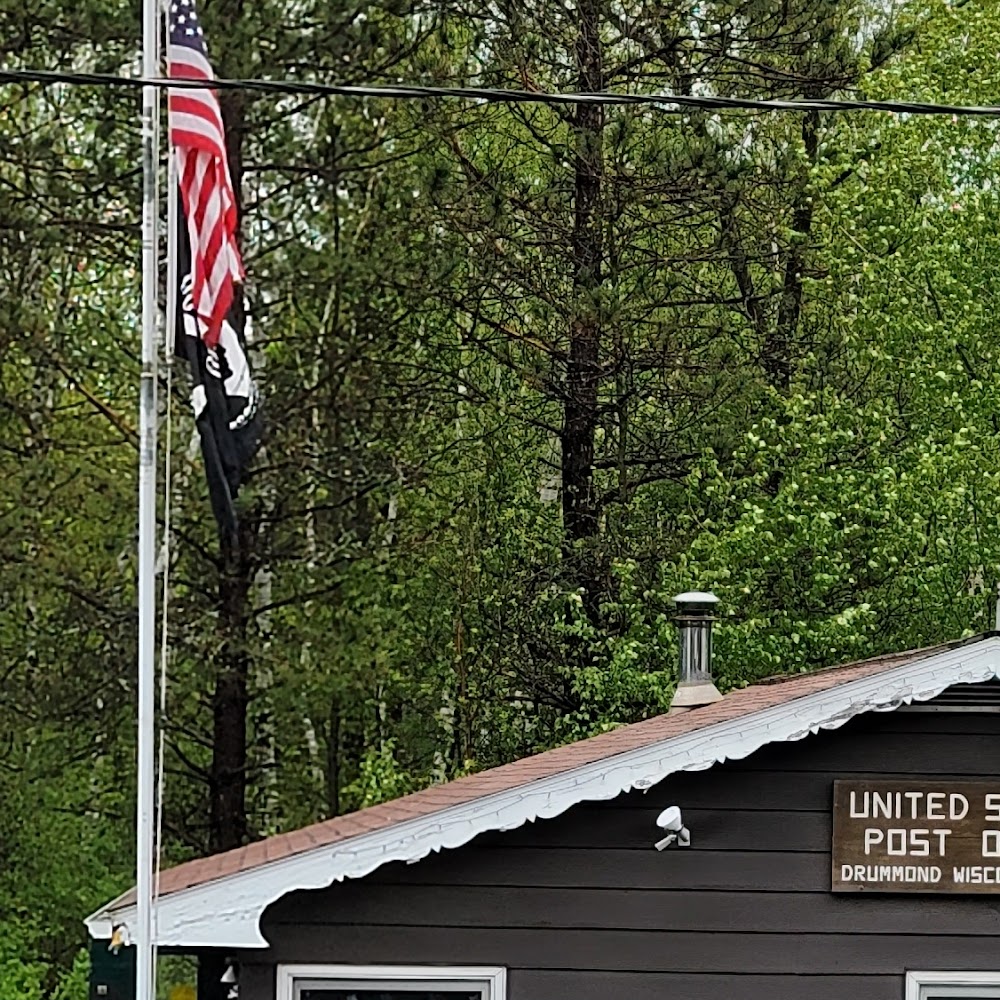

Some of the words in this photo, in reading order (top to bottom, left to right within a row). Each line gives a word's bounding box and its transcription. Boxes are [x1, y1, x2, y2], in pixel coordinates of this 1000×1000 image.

[850, 791, 970, 821] UNITED
[864, 828, 952, 857] POST
[841, 864, 942, 883] DRUMMOND
